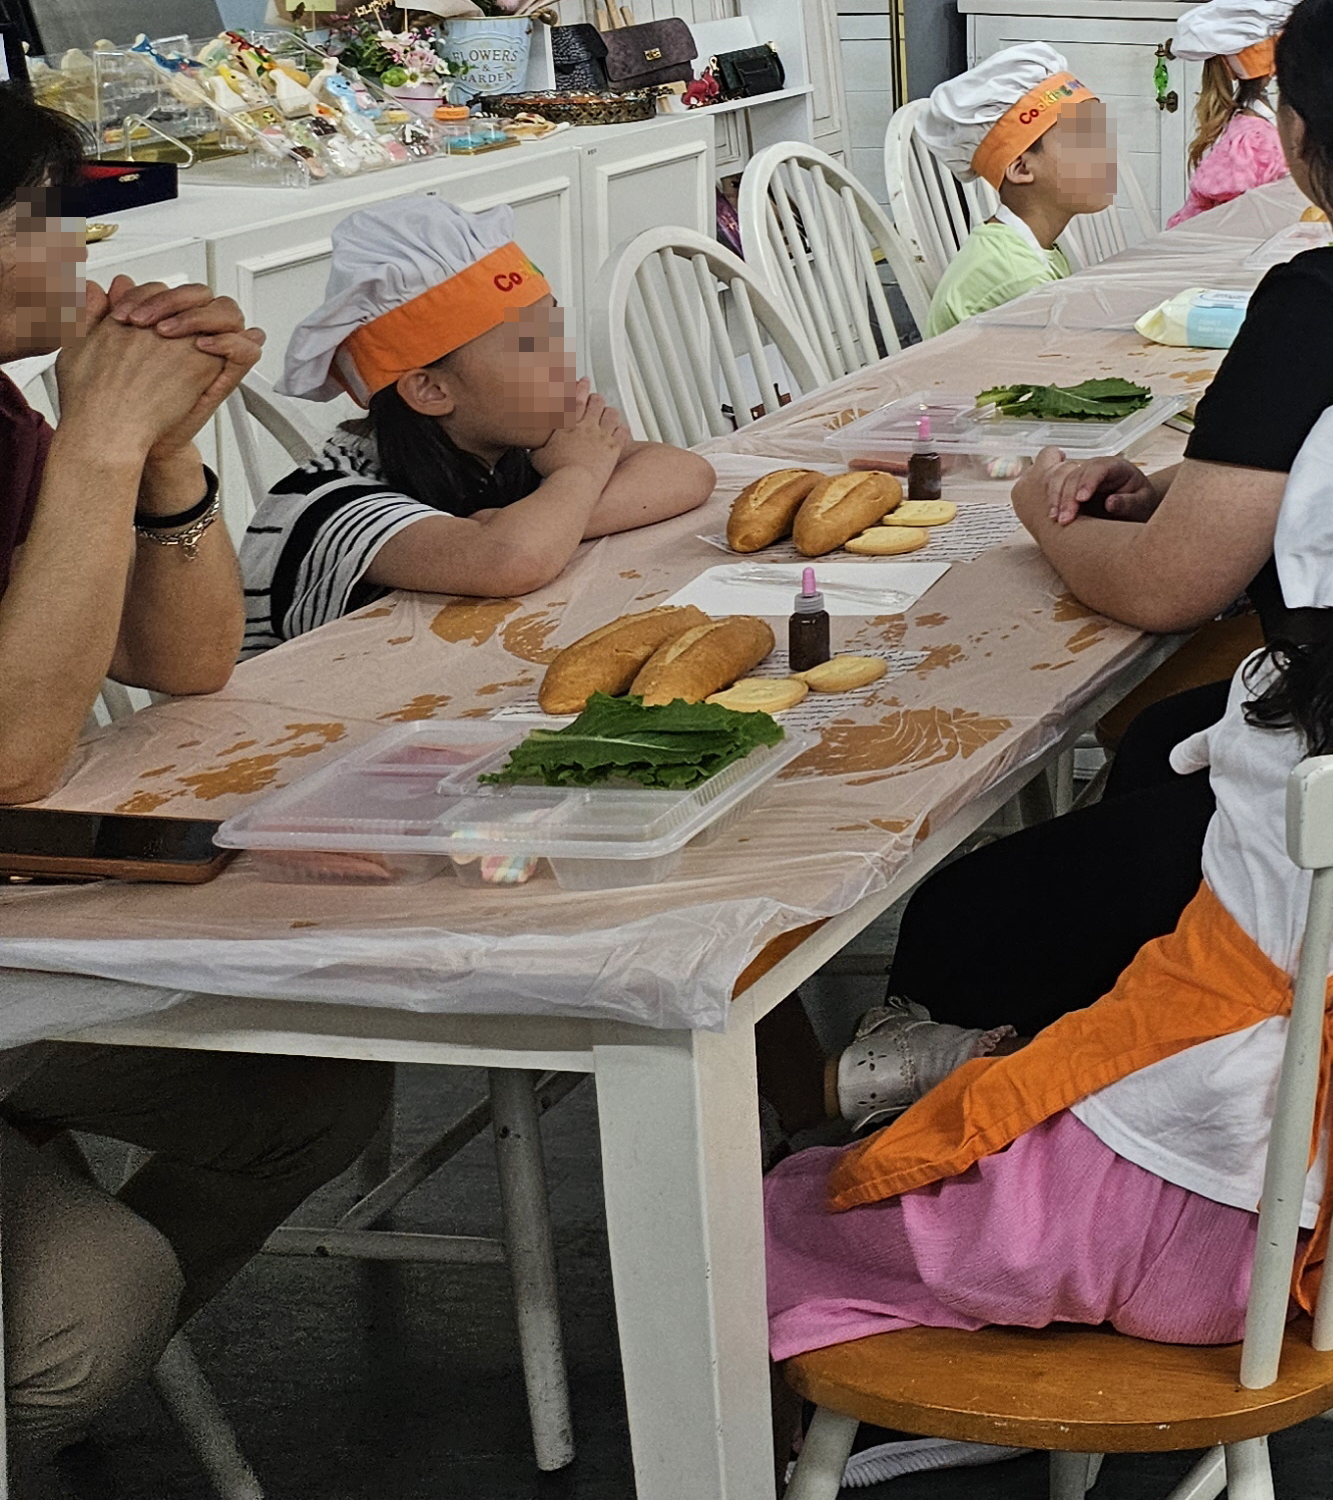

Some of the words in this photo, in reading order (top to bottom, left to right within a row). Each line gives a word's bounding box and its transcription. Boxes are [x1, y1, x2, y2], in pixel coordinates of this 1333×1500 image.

[452, 49, 518, 62] FLOWERS
[482, 63, 490, 72] &
[460, 71, 513, 83] GARDEN
